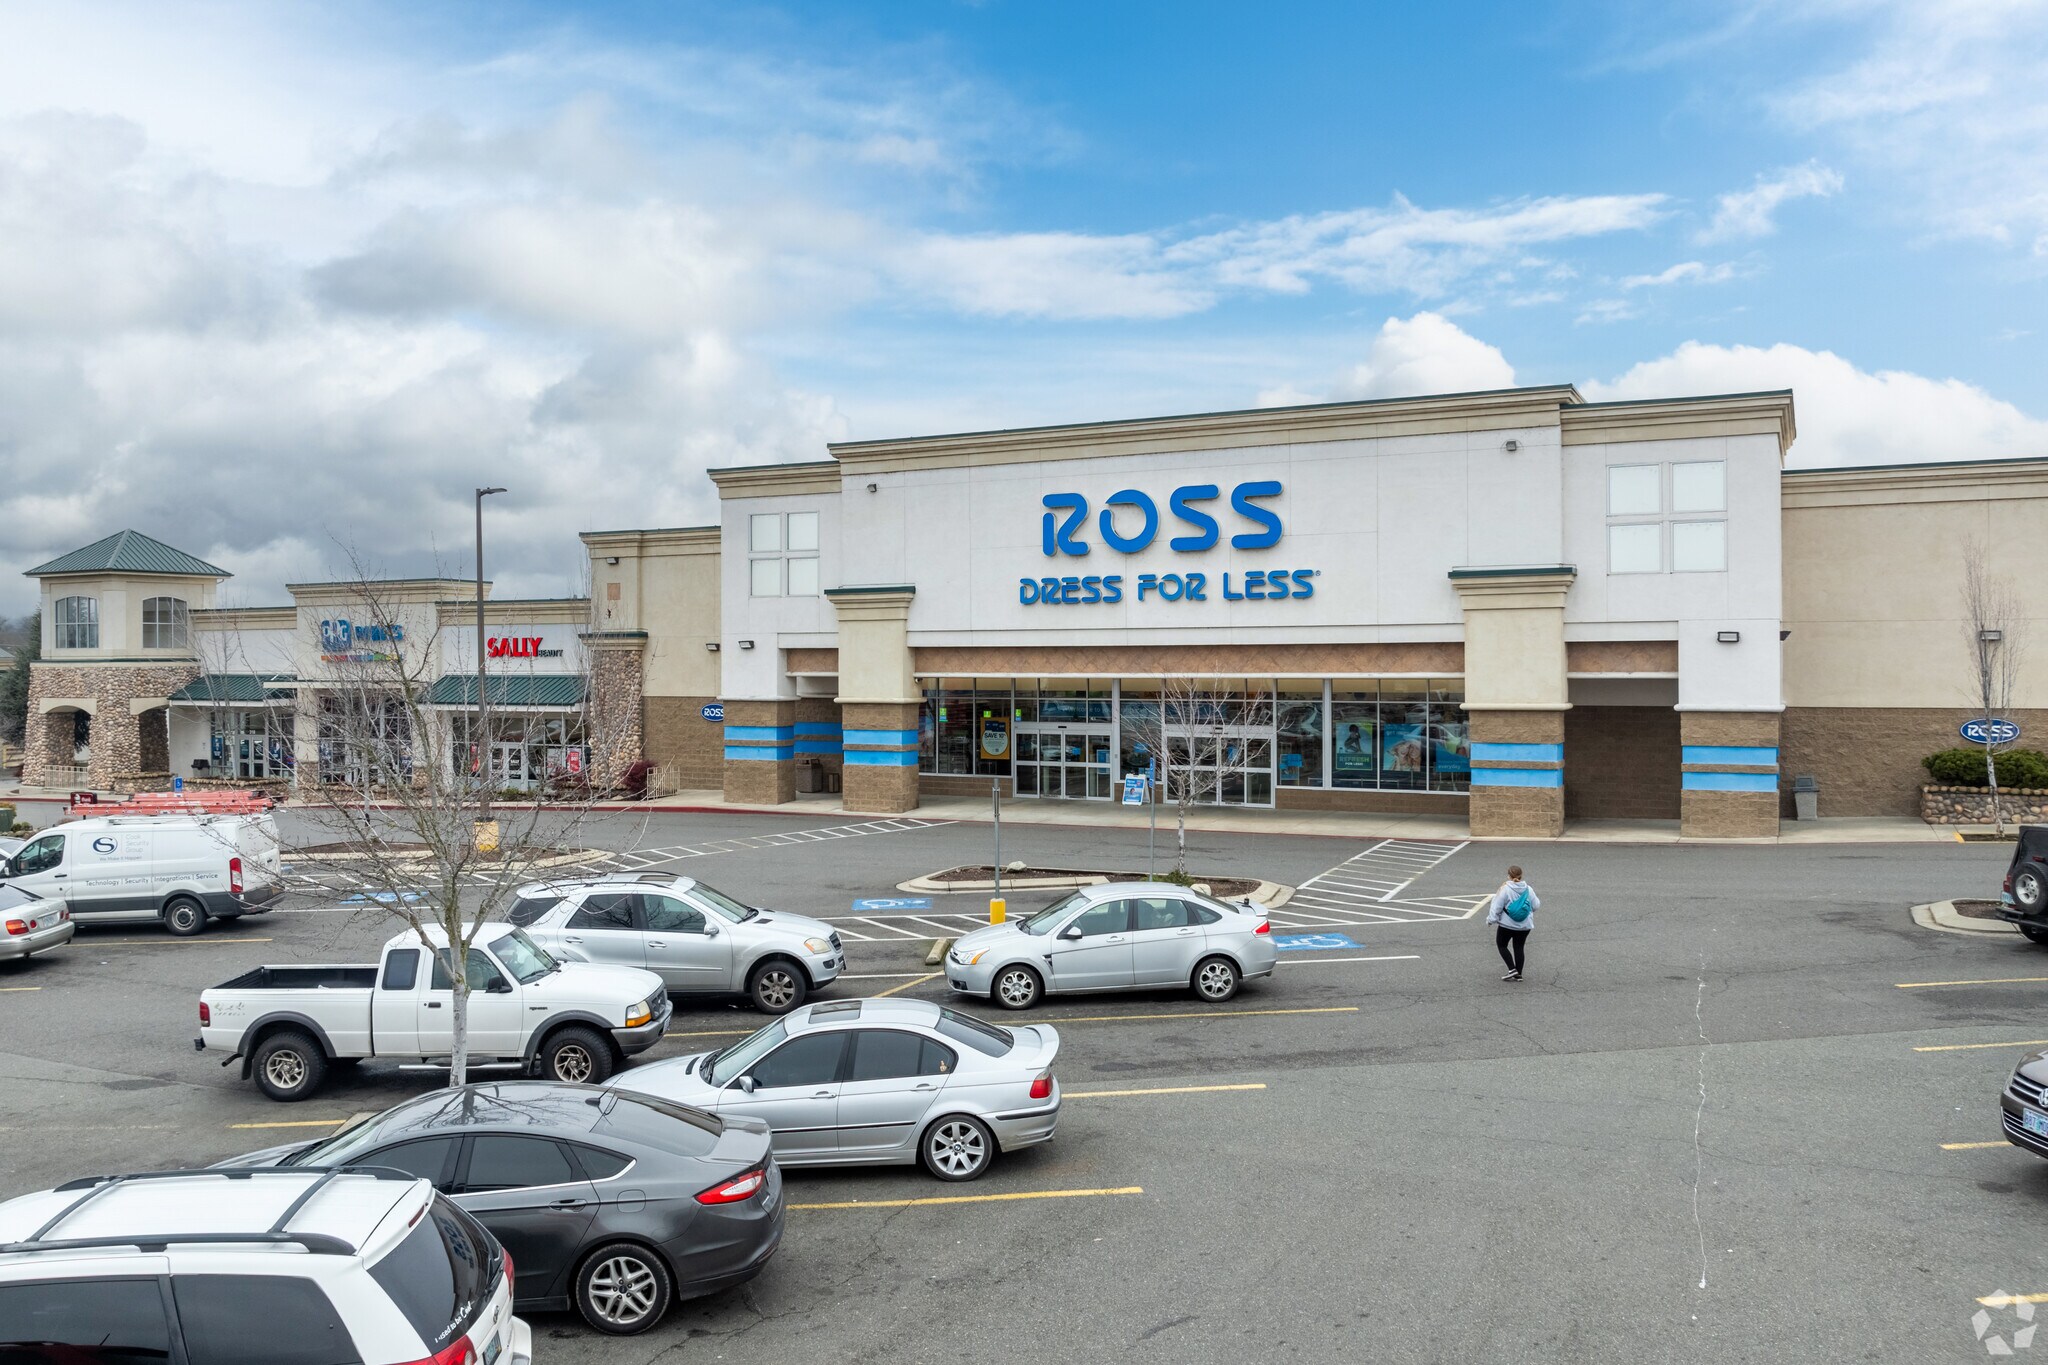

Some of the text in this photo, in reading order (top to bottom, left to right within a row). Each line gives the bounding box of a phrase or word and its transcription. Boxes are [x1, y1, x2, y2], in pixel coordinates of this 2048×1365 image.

[1042, 481, 1284, 557] ROSS
[1019, 569, 1314, 605] DRESS FOR LESS
[487, 636, 543, 658] SALLY
[1967, 724, 2014, 737] ROSS
[85, 879, 119, 887] Technology
[154, 874, 191, 882] Integrations
